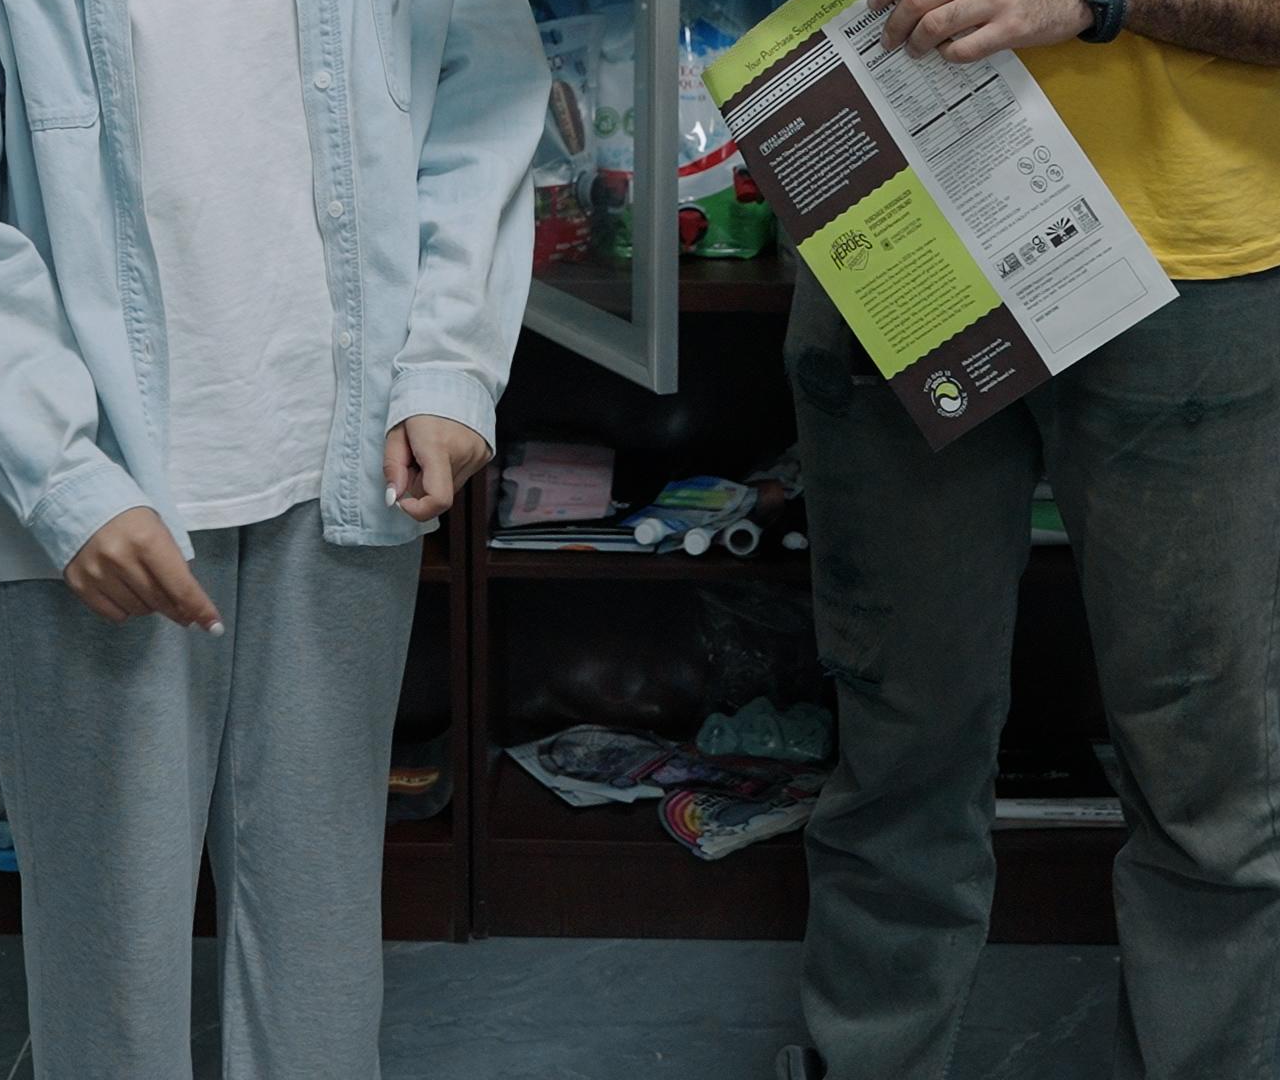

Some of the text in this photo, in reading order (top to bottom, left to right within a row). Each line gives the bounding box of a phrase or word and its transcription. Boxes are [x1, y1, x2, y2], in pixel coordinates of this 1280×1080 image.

[844, 3, 890, 39] Nutrition
[744, 55, 761, 72] Your
[759, 33, 795, 61] Purchase
[791, 12, 825, 37] Supports
[830, 233, 873, 271] HEROES
